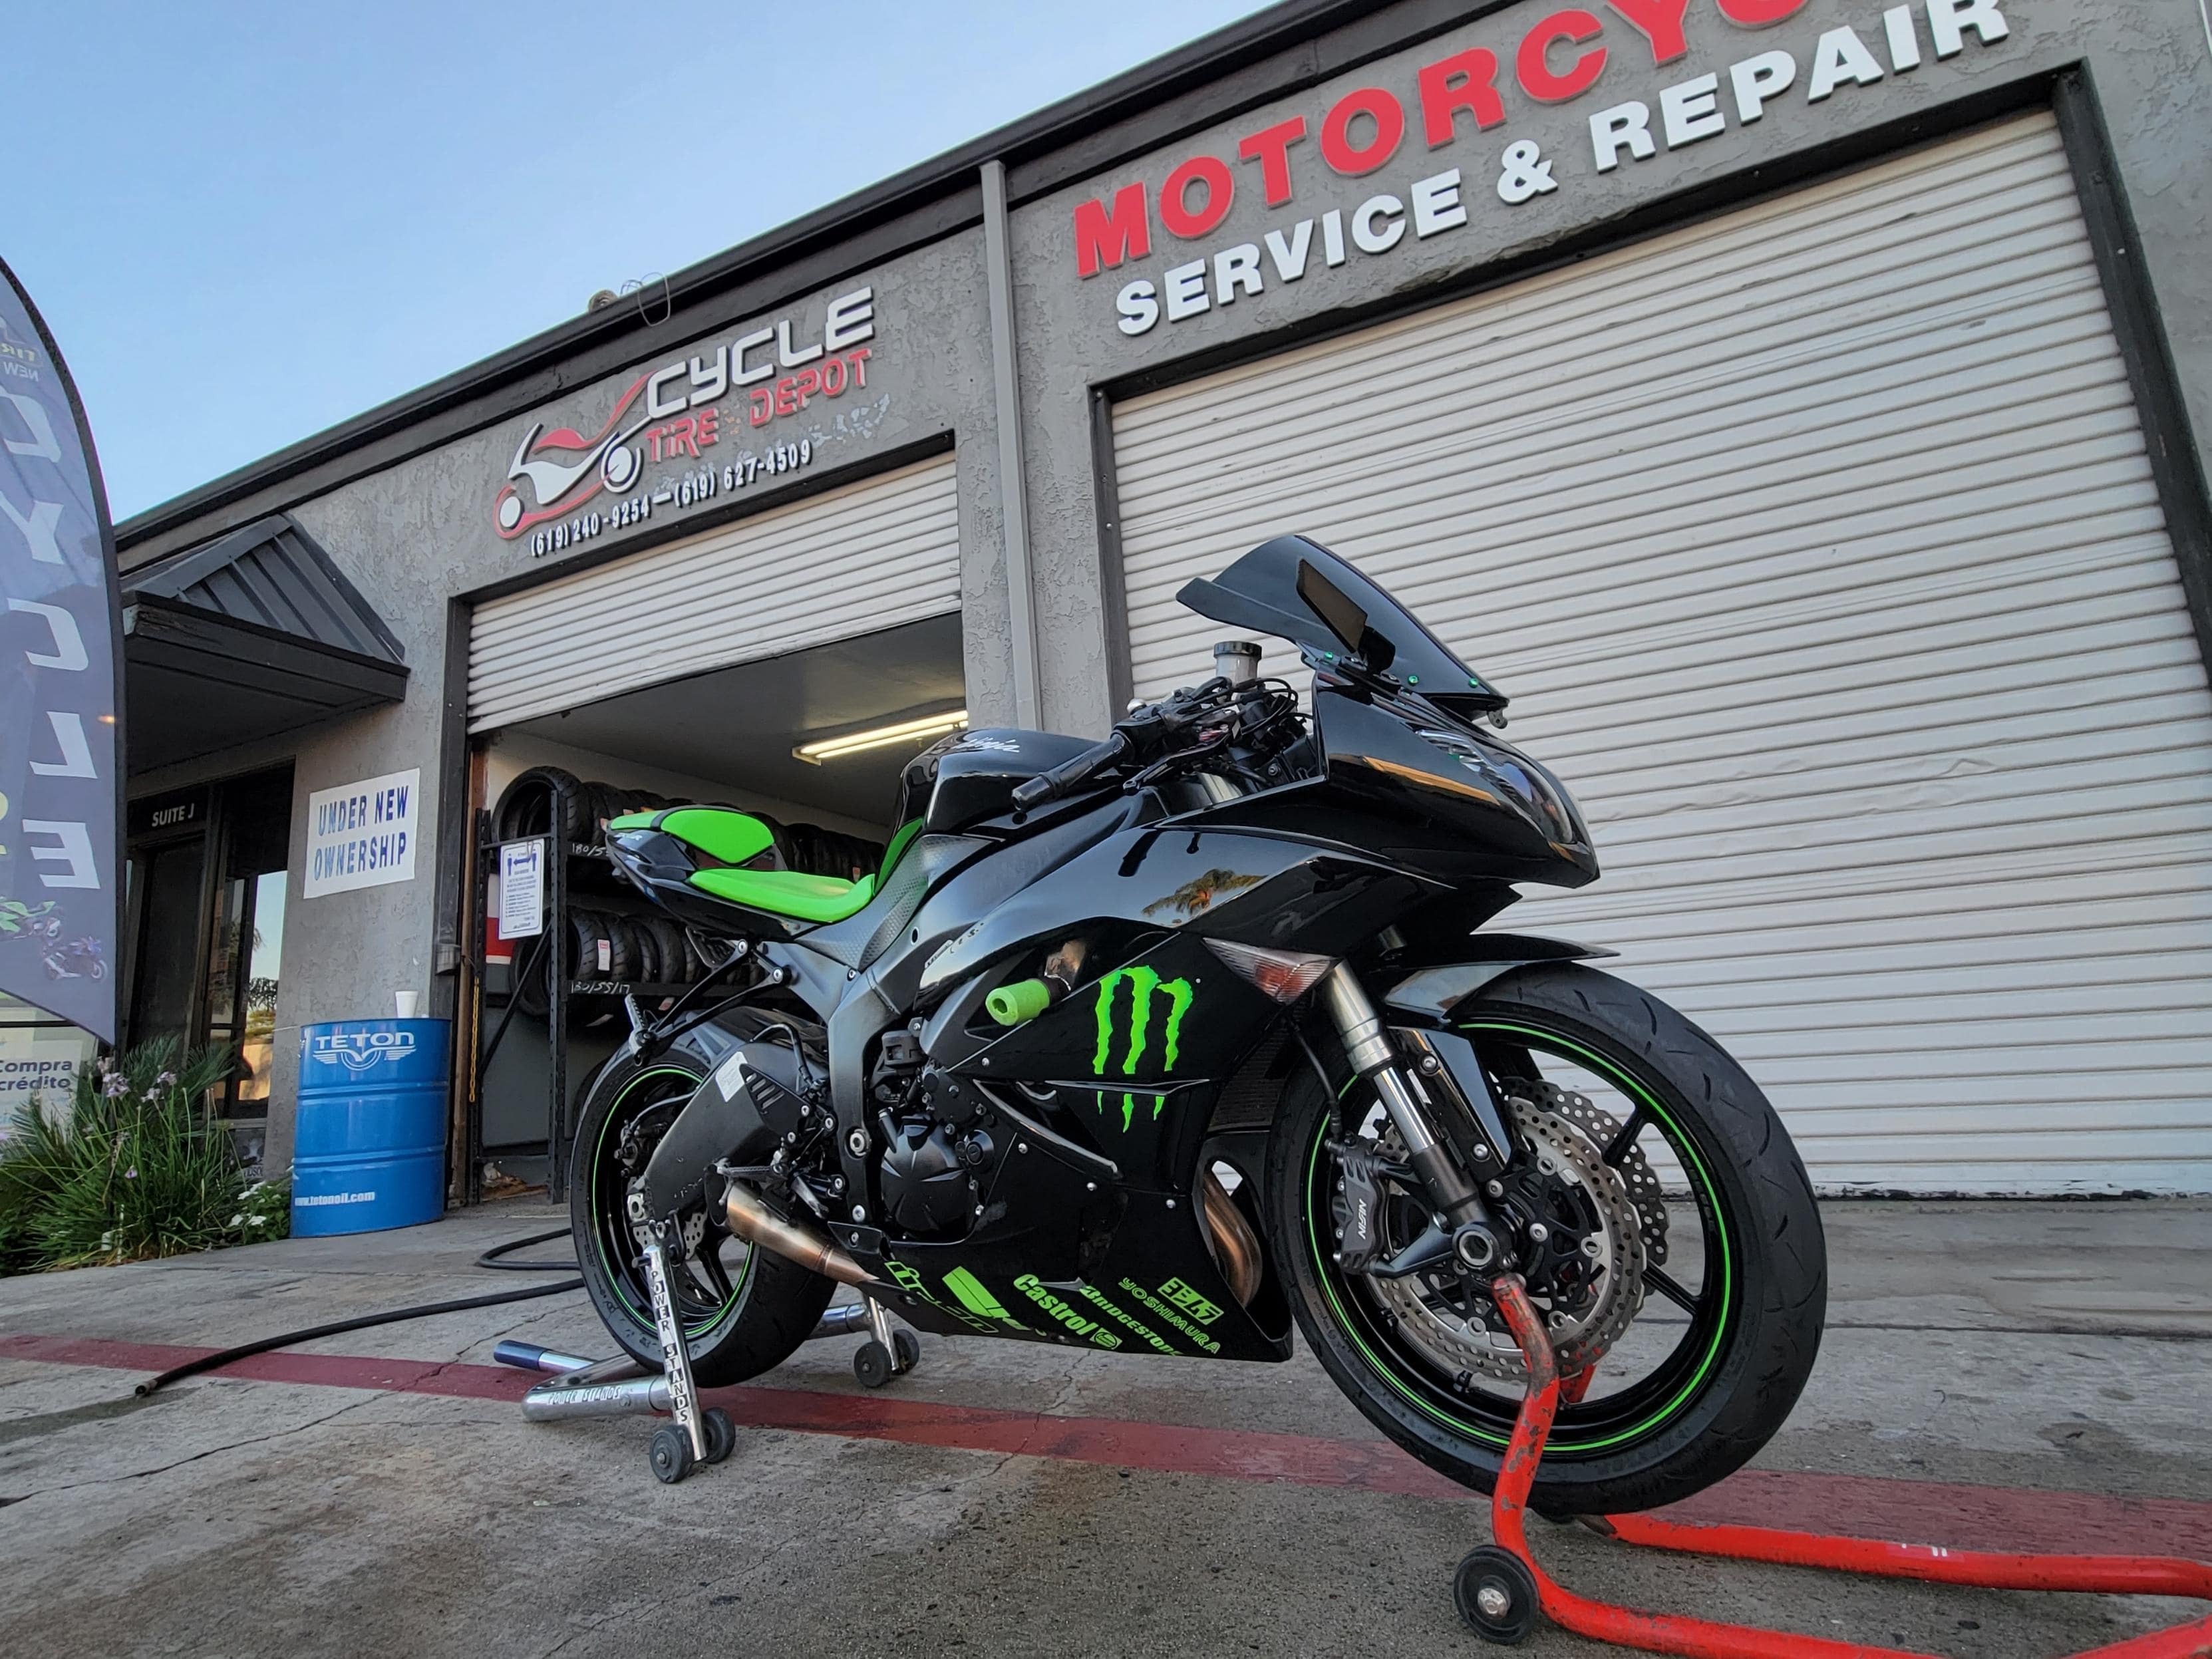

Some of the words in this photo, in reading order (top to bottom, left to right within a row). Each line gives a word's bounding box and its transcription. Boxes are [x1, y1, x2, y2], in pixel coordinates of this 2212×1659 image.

[1073, 0, 1809, 281] MOTORCY
[1116, 168, 1468, 336] SERVICE
[1497, 139, 1558, 206] &
[1589, 0, 2010, 174] REPAIR
[647, 286, 875, 420] CYCLE
[645, 406, 720, 463] TIRE
[749, 347, 873, 428] DEPOT
[674, 470, 716, 508] (619)
[723, 438, 812, 492] 627-4509
[152, 806, 186, 828] SUITE
[187, 803, 195, 819] J
[319, 795, 367, 837] UNDER
[375, 785, 409, 824] NEW
[314, 831, 407, 881] OWNERSHIP
[572, 842, 609, 857] 180/5
[315, 1032, 415, 1050] TETON
[651, 1270, 671, 1332] POWER
[1013, 1273, 1099, 1336] Castrol
[1118, 1277, 1221, 1355] YOSHIMURA
[665, 1344, 689, 1423] STANDS
